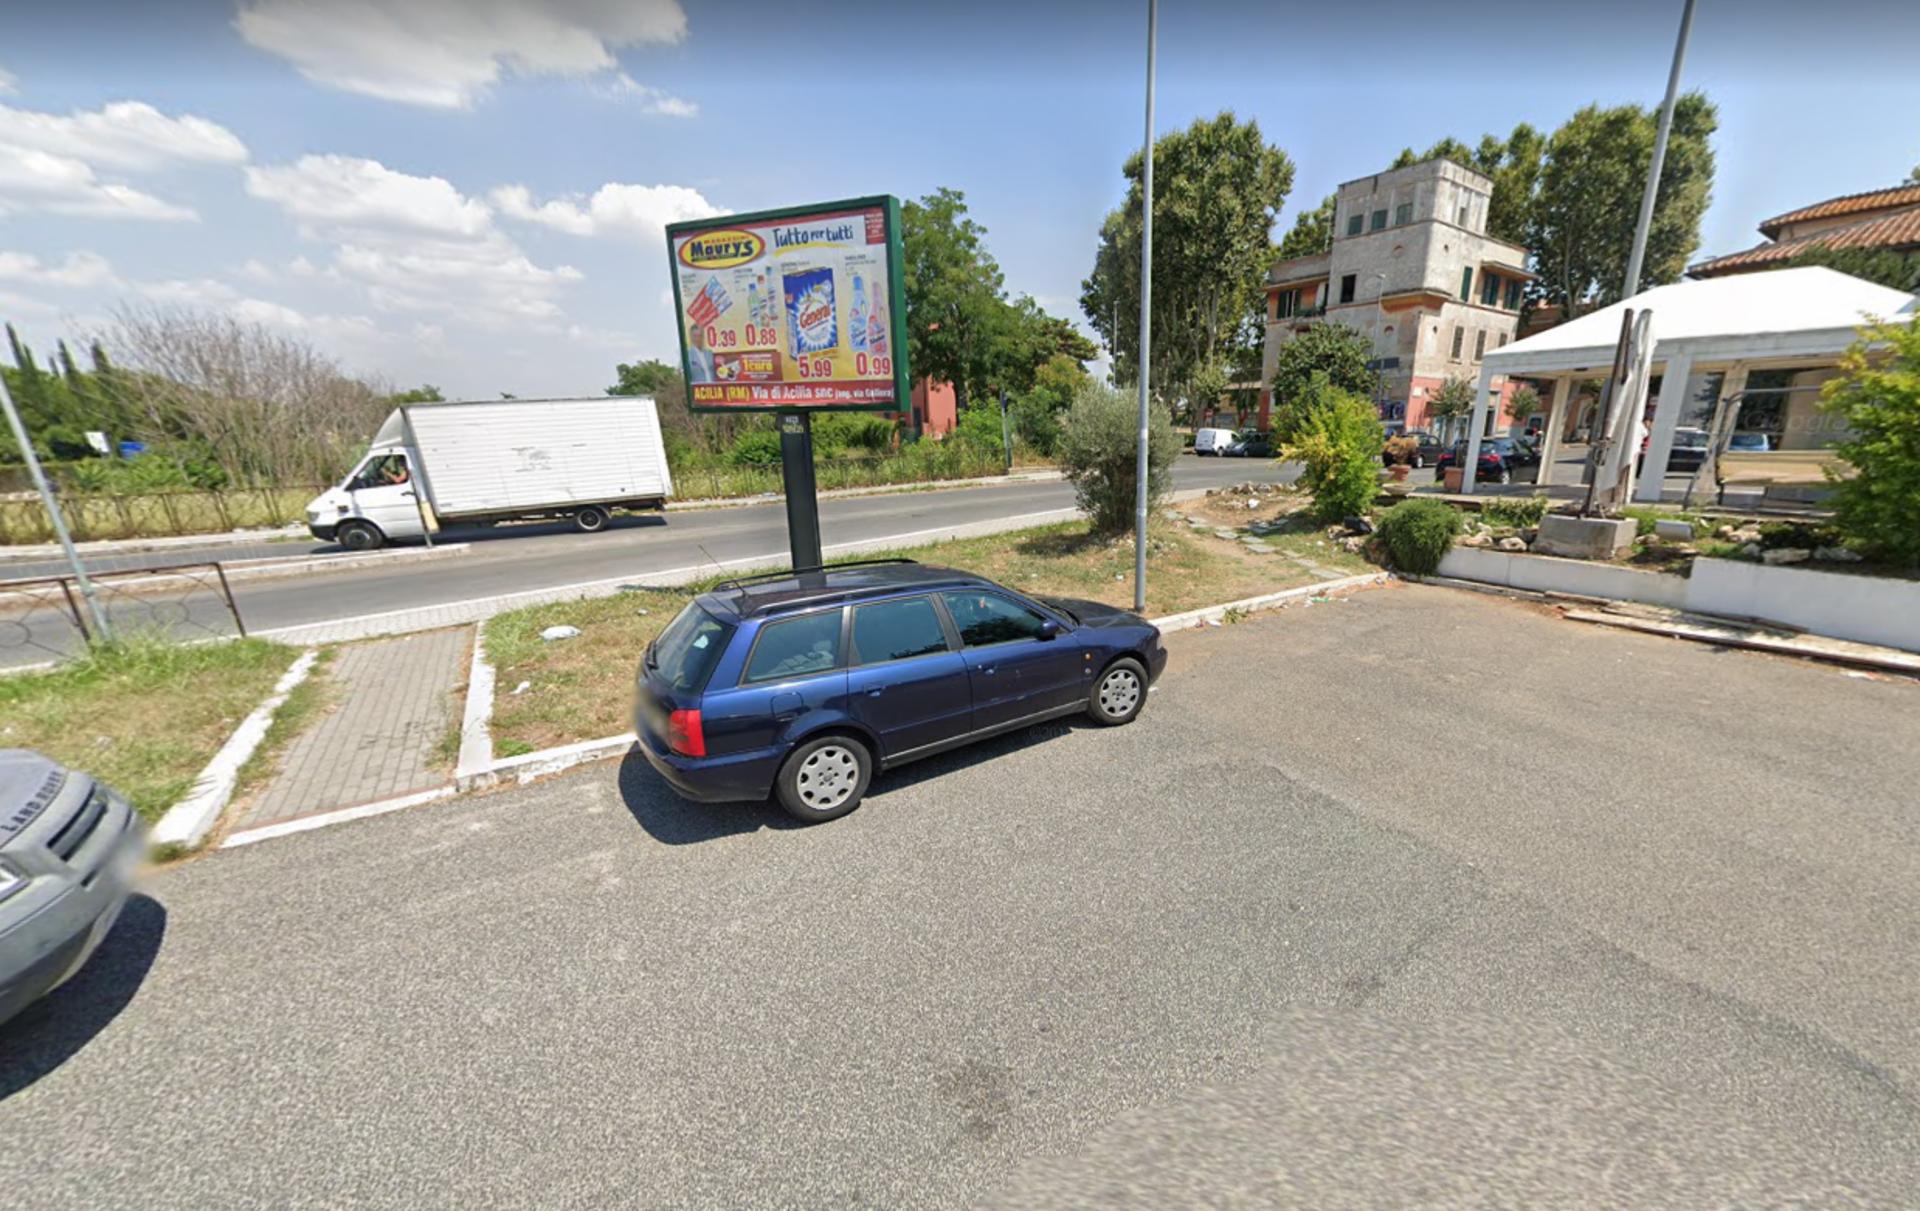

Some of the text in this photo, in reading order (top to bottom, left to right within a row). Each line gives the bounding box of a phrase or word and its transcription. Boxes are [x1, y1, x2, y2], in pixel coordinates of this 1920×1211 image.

[773, 228, 809, 248] Tutto
[826, 225, 854, 241] tutti
[800, 304, 830, 328] General
[707, 326, 737, 347] 0.39
[746, 324, 777, 346] 0.88
[799, 356, 832, 378] 5.99
[856, 352, 891, 376] 0.99
[694, 387, 723, 400] ACILIA
[727, 386, 750, 401] (RM)
[752, 385, 769, 399] Via
[771, 385, 781, 399] di
[783, 385, 813, 399] Acilia
[0, 801, 41, 832] LAND
